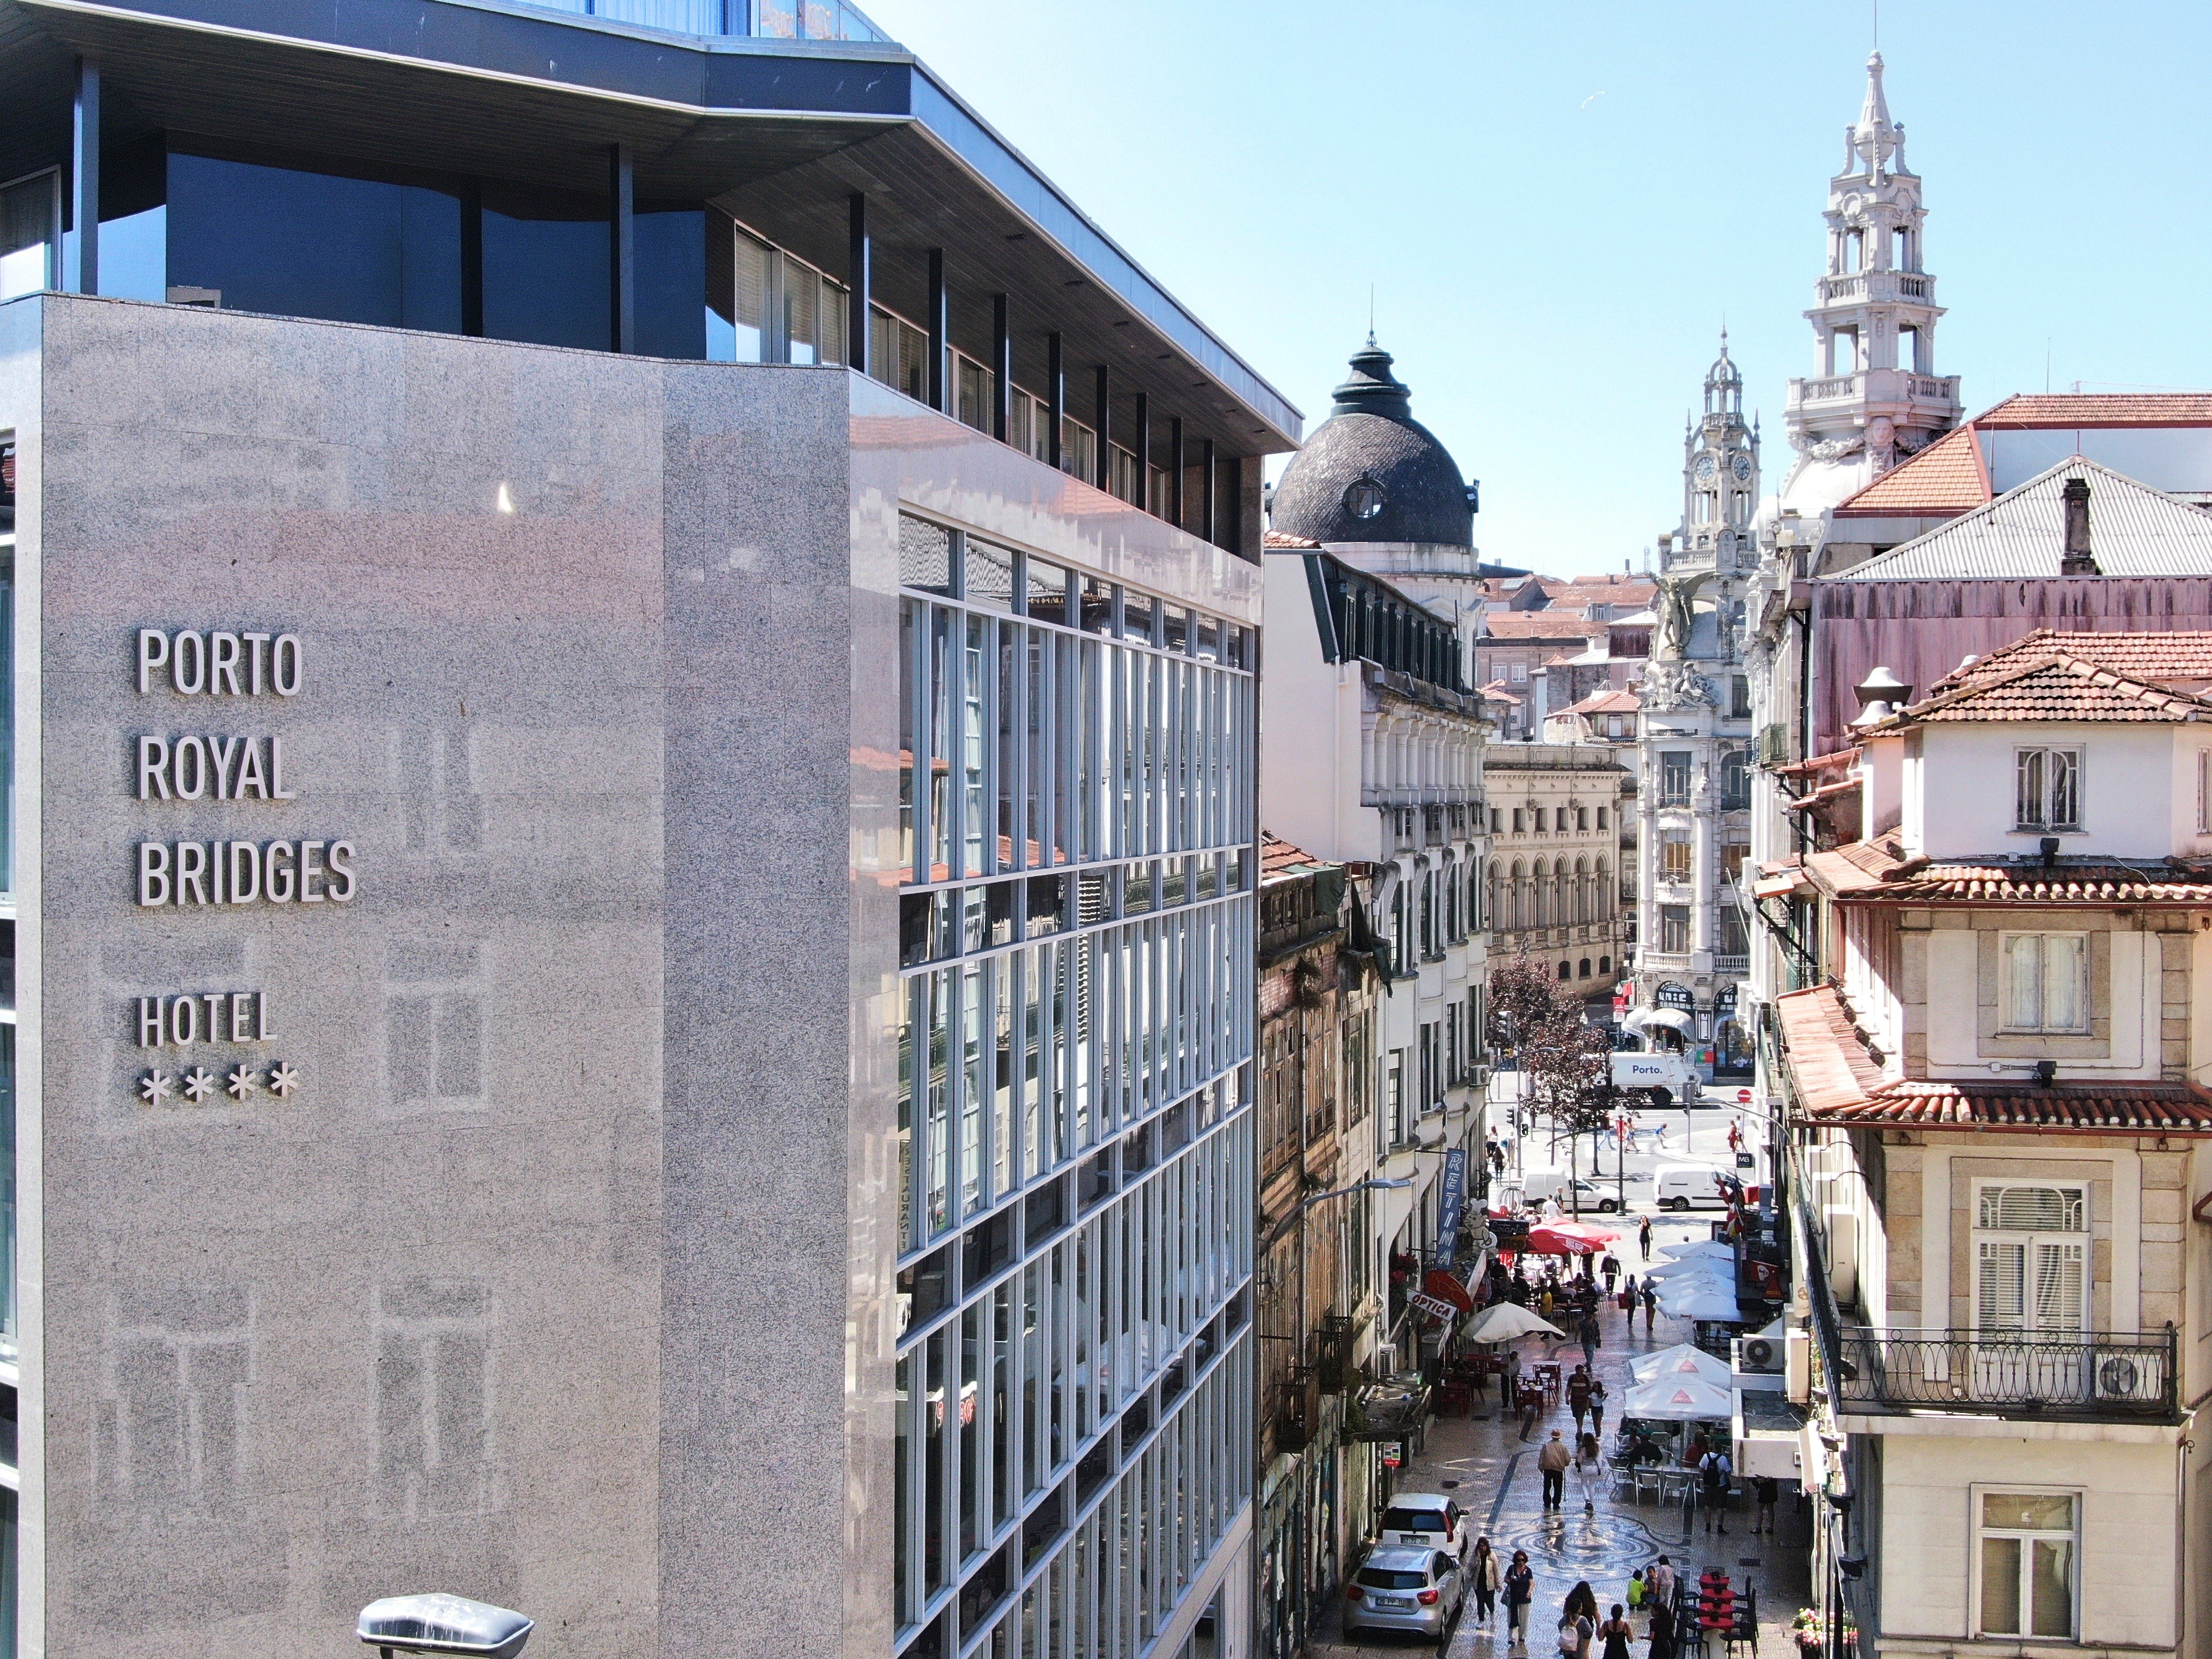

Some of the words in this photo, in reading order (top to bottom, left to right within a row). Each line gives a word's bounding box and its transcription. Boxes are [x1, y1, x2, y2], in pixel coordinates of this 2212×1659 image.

[138, 629, 303, 696] PORTO
[137, 735, 295, 801] ROYAL
[137, 840, 357, 907] BRIDGES
[138, 992, 278, 1048] HOTEL
[1632, 1065, 1663, 1074] Porto.
[1438, 1154, 1462, 1265] RETINA
